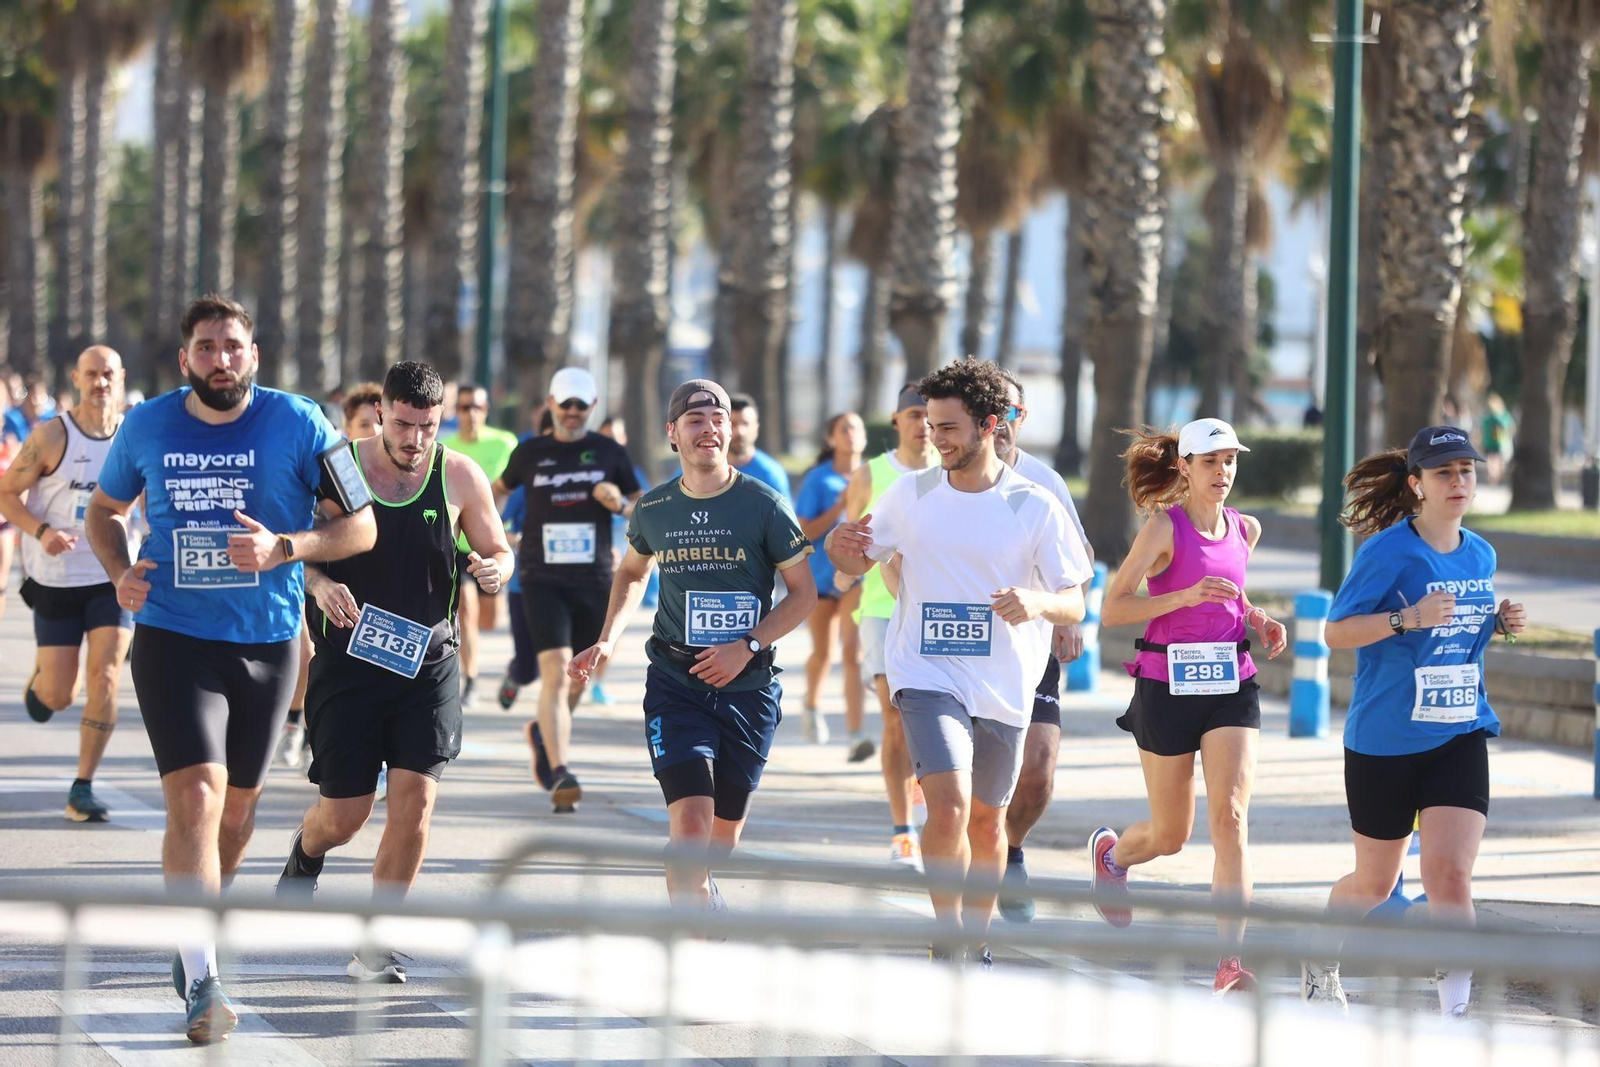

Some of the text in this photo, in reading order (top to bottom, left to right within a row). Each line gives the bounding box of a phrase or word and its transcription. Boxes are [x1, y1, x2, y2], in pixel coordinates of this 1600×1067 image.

[164, 449, 255, 471] mayoral
[165, 477, 249, 491] RUNNING
[174, 488, 243, 501] MAKES
[174, 499, 246, 511] FRIENDS
[665, 530, 695, 538] SIERRA
[678, 537, 717, 545] ESTATES
[185, 551, 231, 567] 213
[654, 546, 747, 564] MARBELLA
[663, 565, 685, 574] HALF
[1426, 579, 1494, 598] mayora
[372, 619, 397, 632] Solidaria
[374, 614, 395, 626] Carrera
[696, 612, 750, 629] 1694
[929, 622, 984, 639] 1685
[361, 627, 418, 659] 2138
[1184, 664, 1224, 680] 298
[1426, 688, 1475, 706] 1186
[649, 716, 666, 759] FILA
